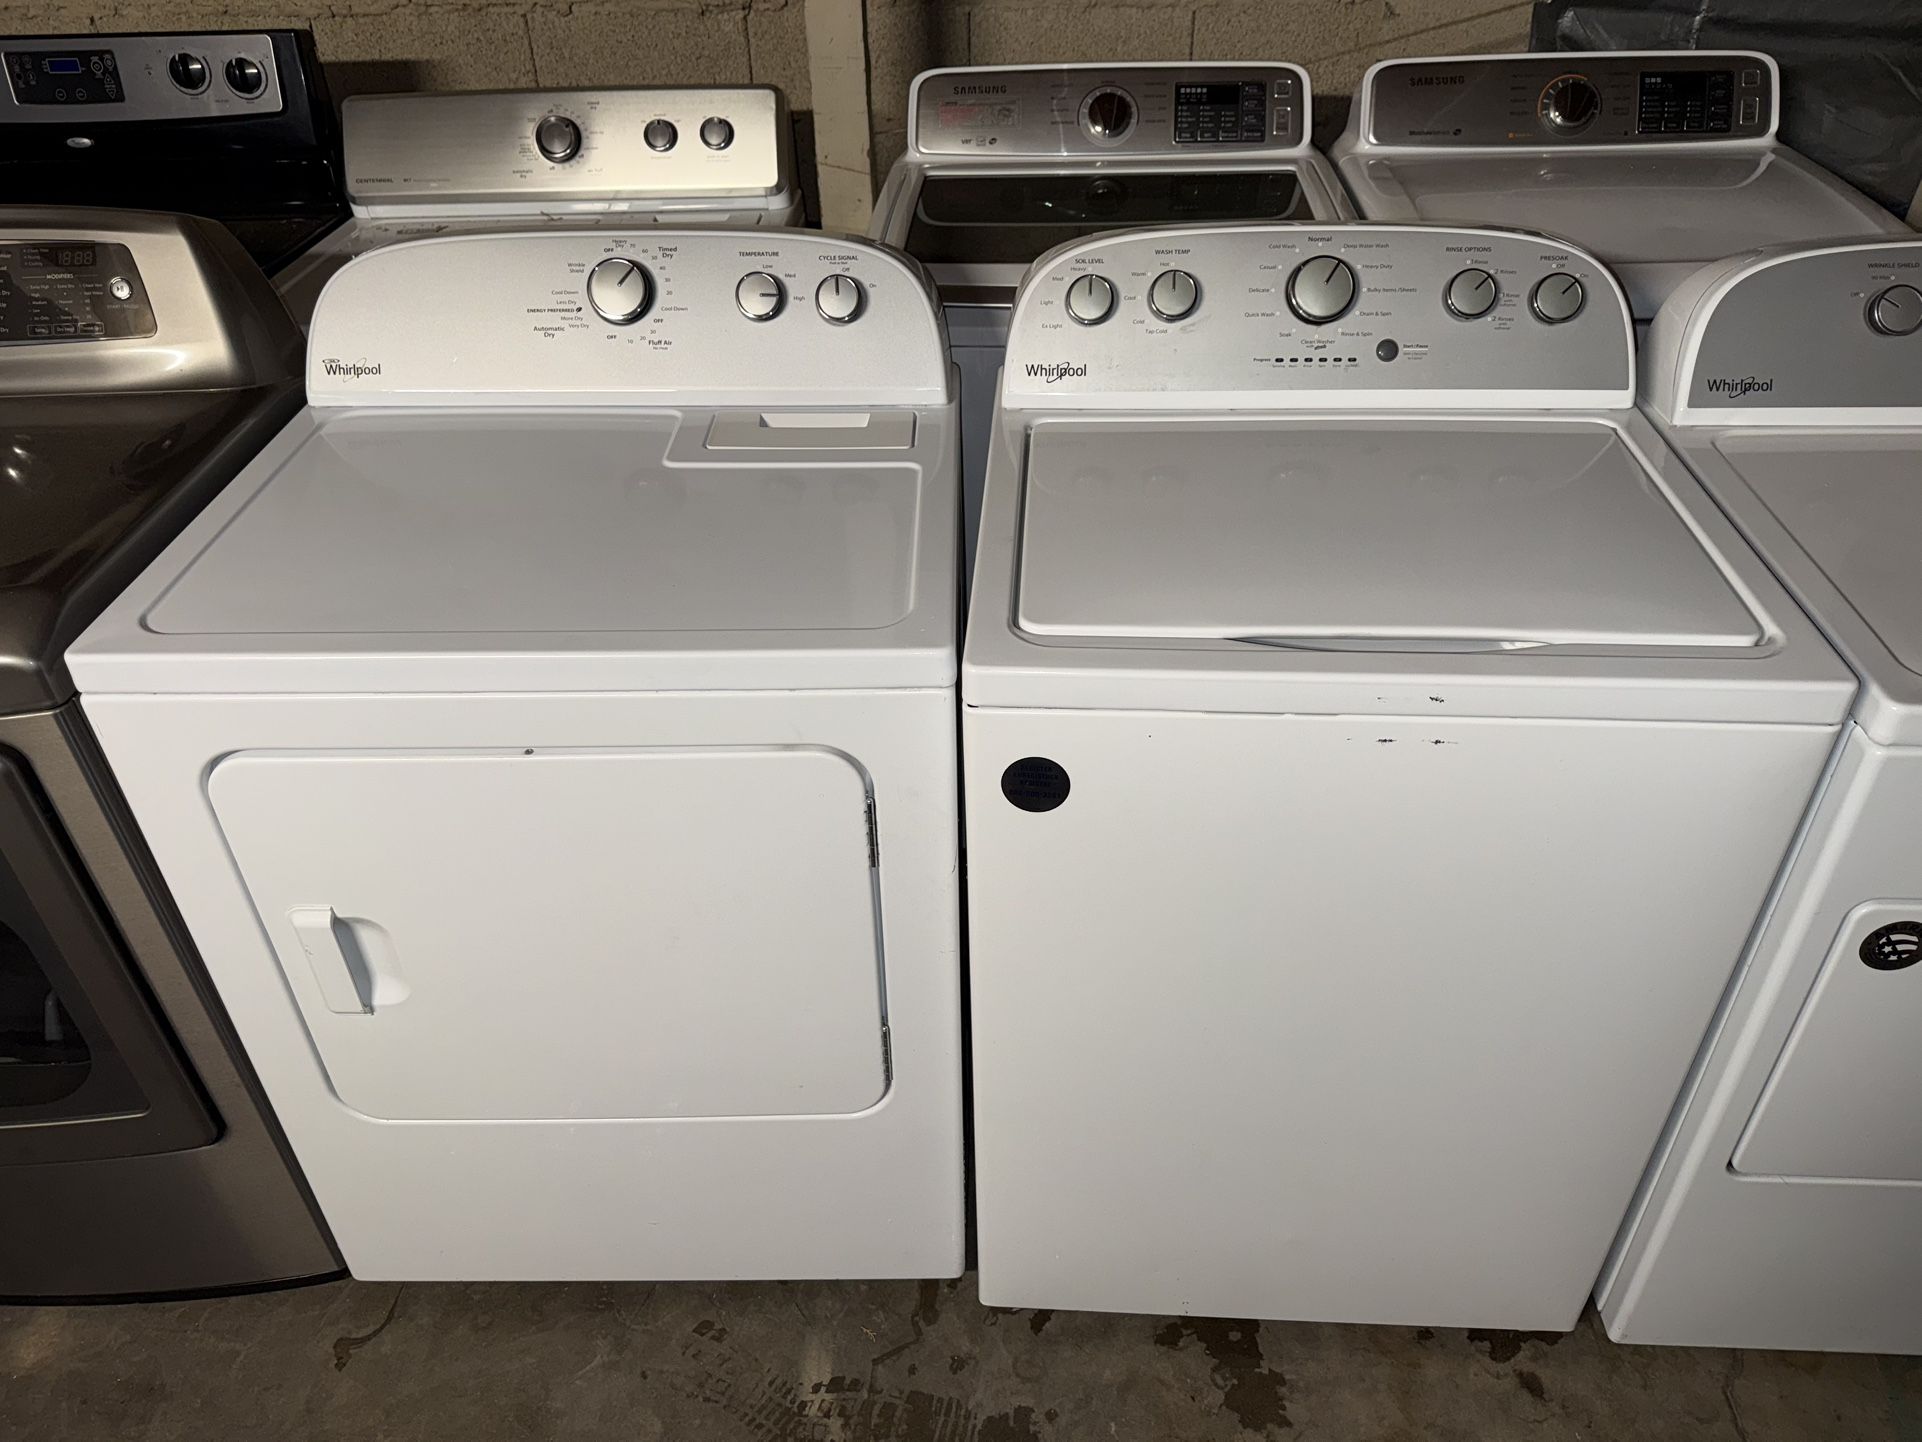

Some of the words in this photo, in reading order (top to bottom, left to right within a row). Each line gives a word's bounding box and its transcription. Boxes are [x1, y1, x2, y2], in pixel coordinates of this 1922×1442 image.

[954, 84, 1007, 94] SAMSUNG
[1410, 76, 1464, 87] SAMSUNG
[324, 362, 381, 380] Whirlpool
[1026, 363, 1087, 381] Whirlpool
[1707, 378, 1773, 396] Whirlpool
